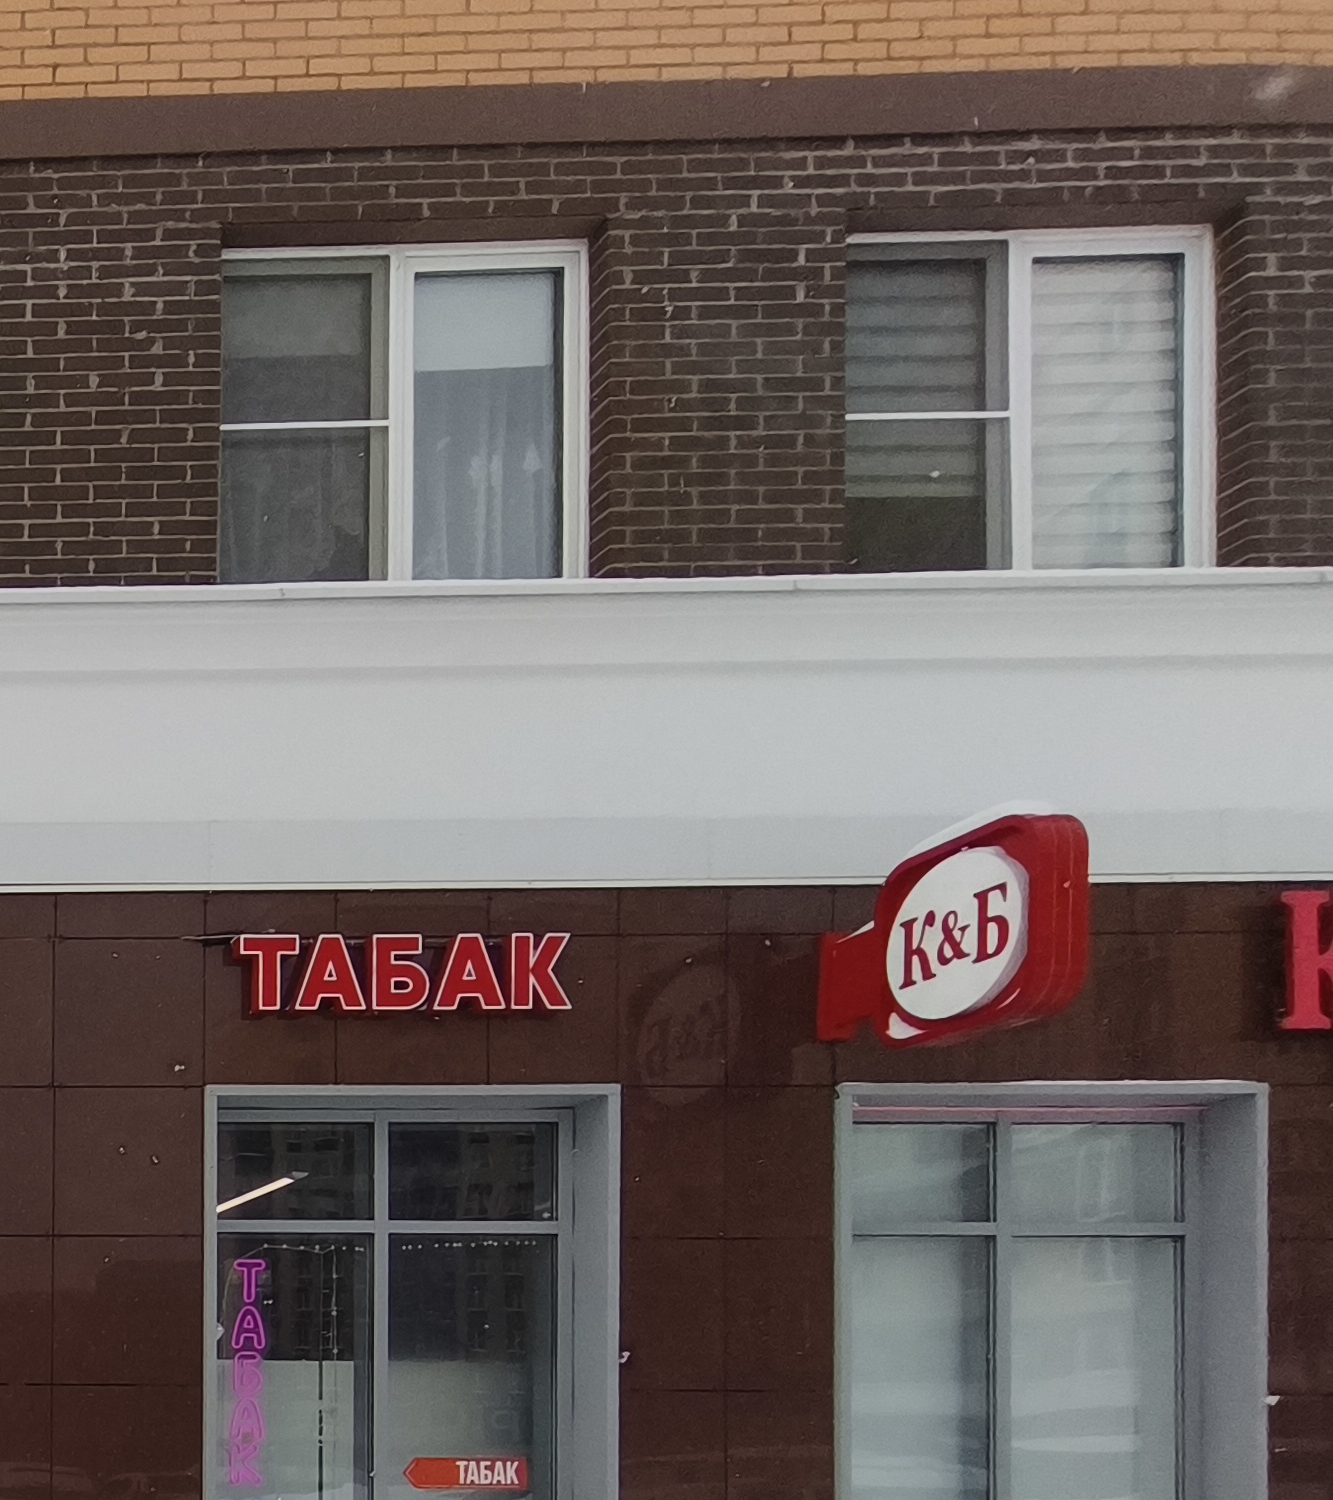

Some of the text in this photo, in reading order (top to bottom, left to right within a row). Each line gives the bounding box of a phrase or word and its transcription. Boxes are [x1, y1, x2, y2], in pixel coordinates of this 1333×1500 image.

[239, 932, 572, 1010] ТАБАК
[898, 881, 1010, 991] К&Б
[229, 1259, 266, 1486] ТАБАК
[455, 1461, 519, 1485] ТАБАК
